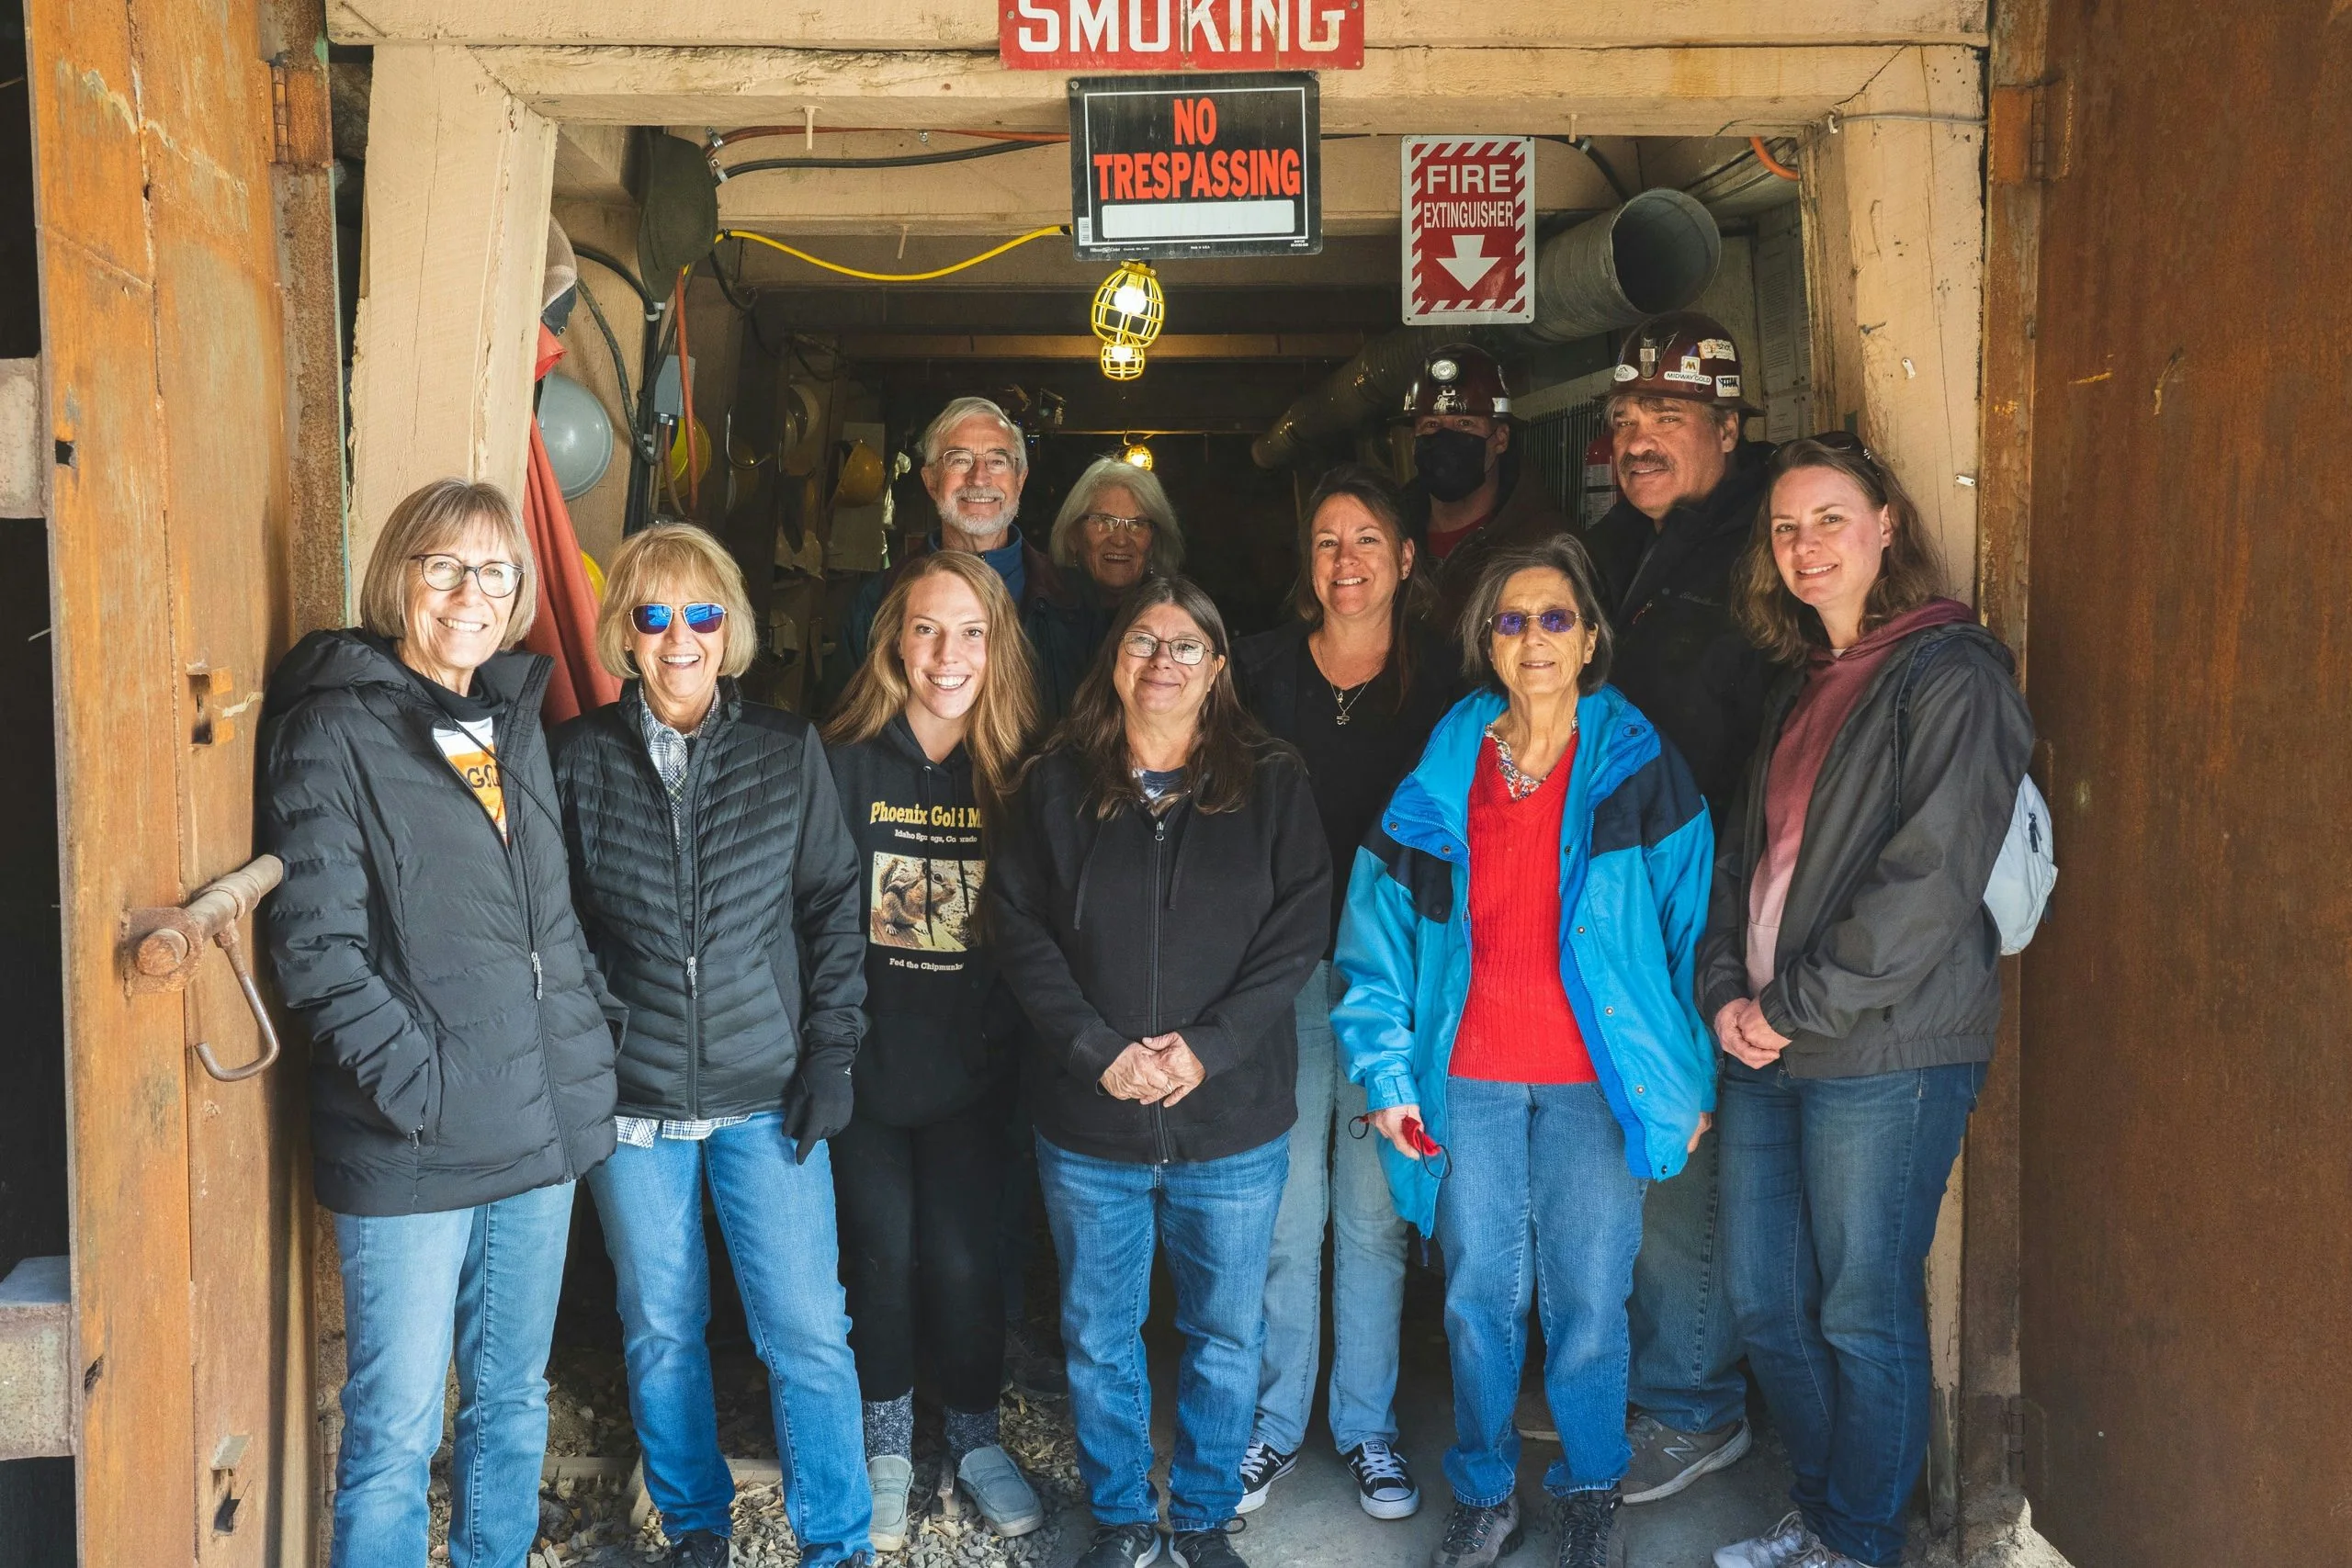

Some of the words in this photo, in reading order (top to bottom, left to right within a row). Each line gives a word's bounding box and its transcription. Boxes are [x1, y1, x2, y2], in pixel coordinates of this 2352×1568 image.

[1019, 0, 1345, 52] SMOKING
[1173, 97, 1217, 145] NO
[1093, 148, 1301, 200] TRESPASSING
[1427, 164, 1511, 194] FIRE
[1423, 200, 1514, 228] EXTINGUISHER
[1693, 375, 1711, 383] GOLD
[870, 801, 928, 825] Phoenix
[894, 829, 915, 840] Idaho
[916, 833, 944, 843] Sprngs,
[906, 961, 919, 969] the
